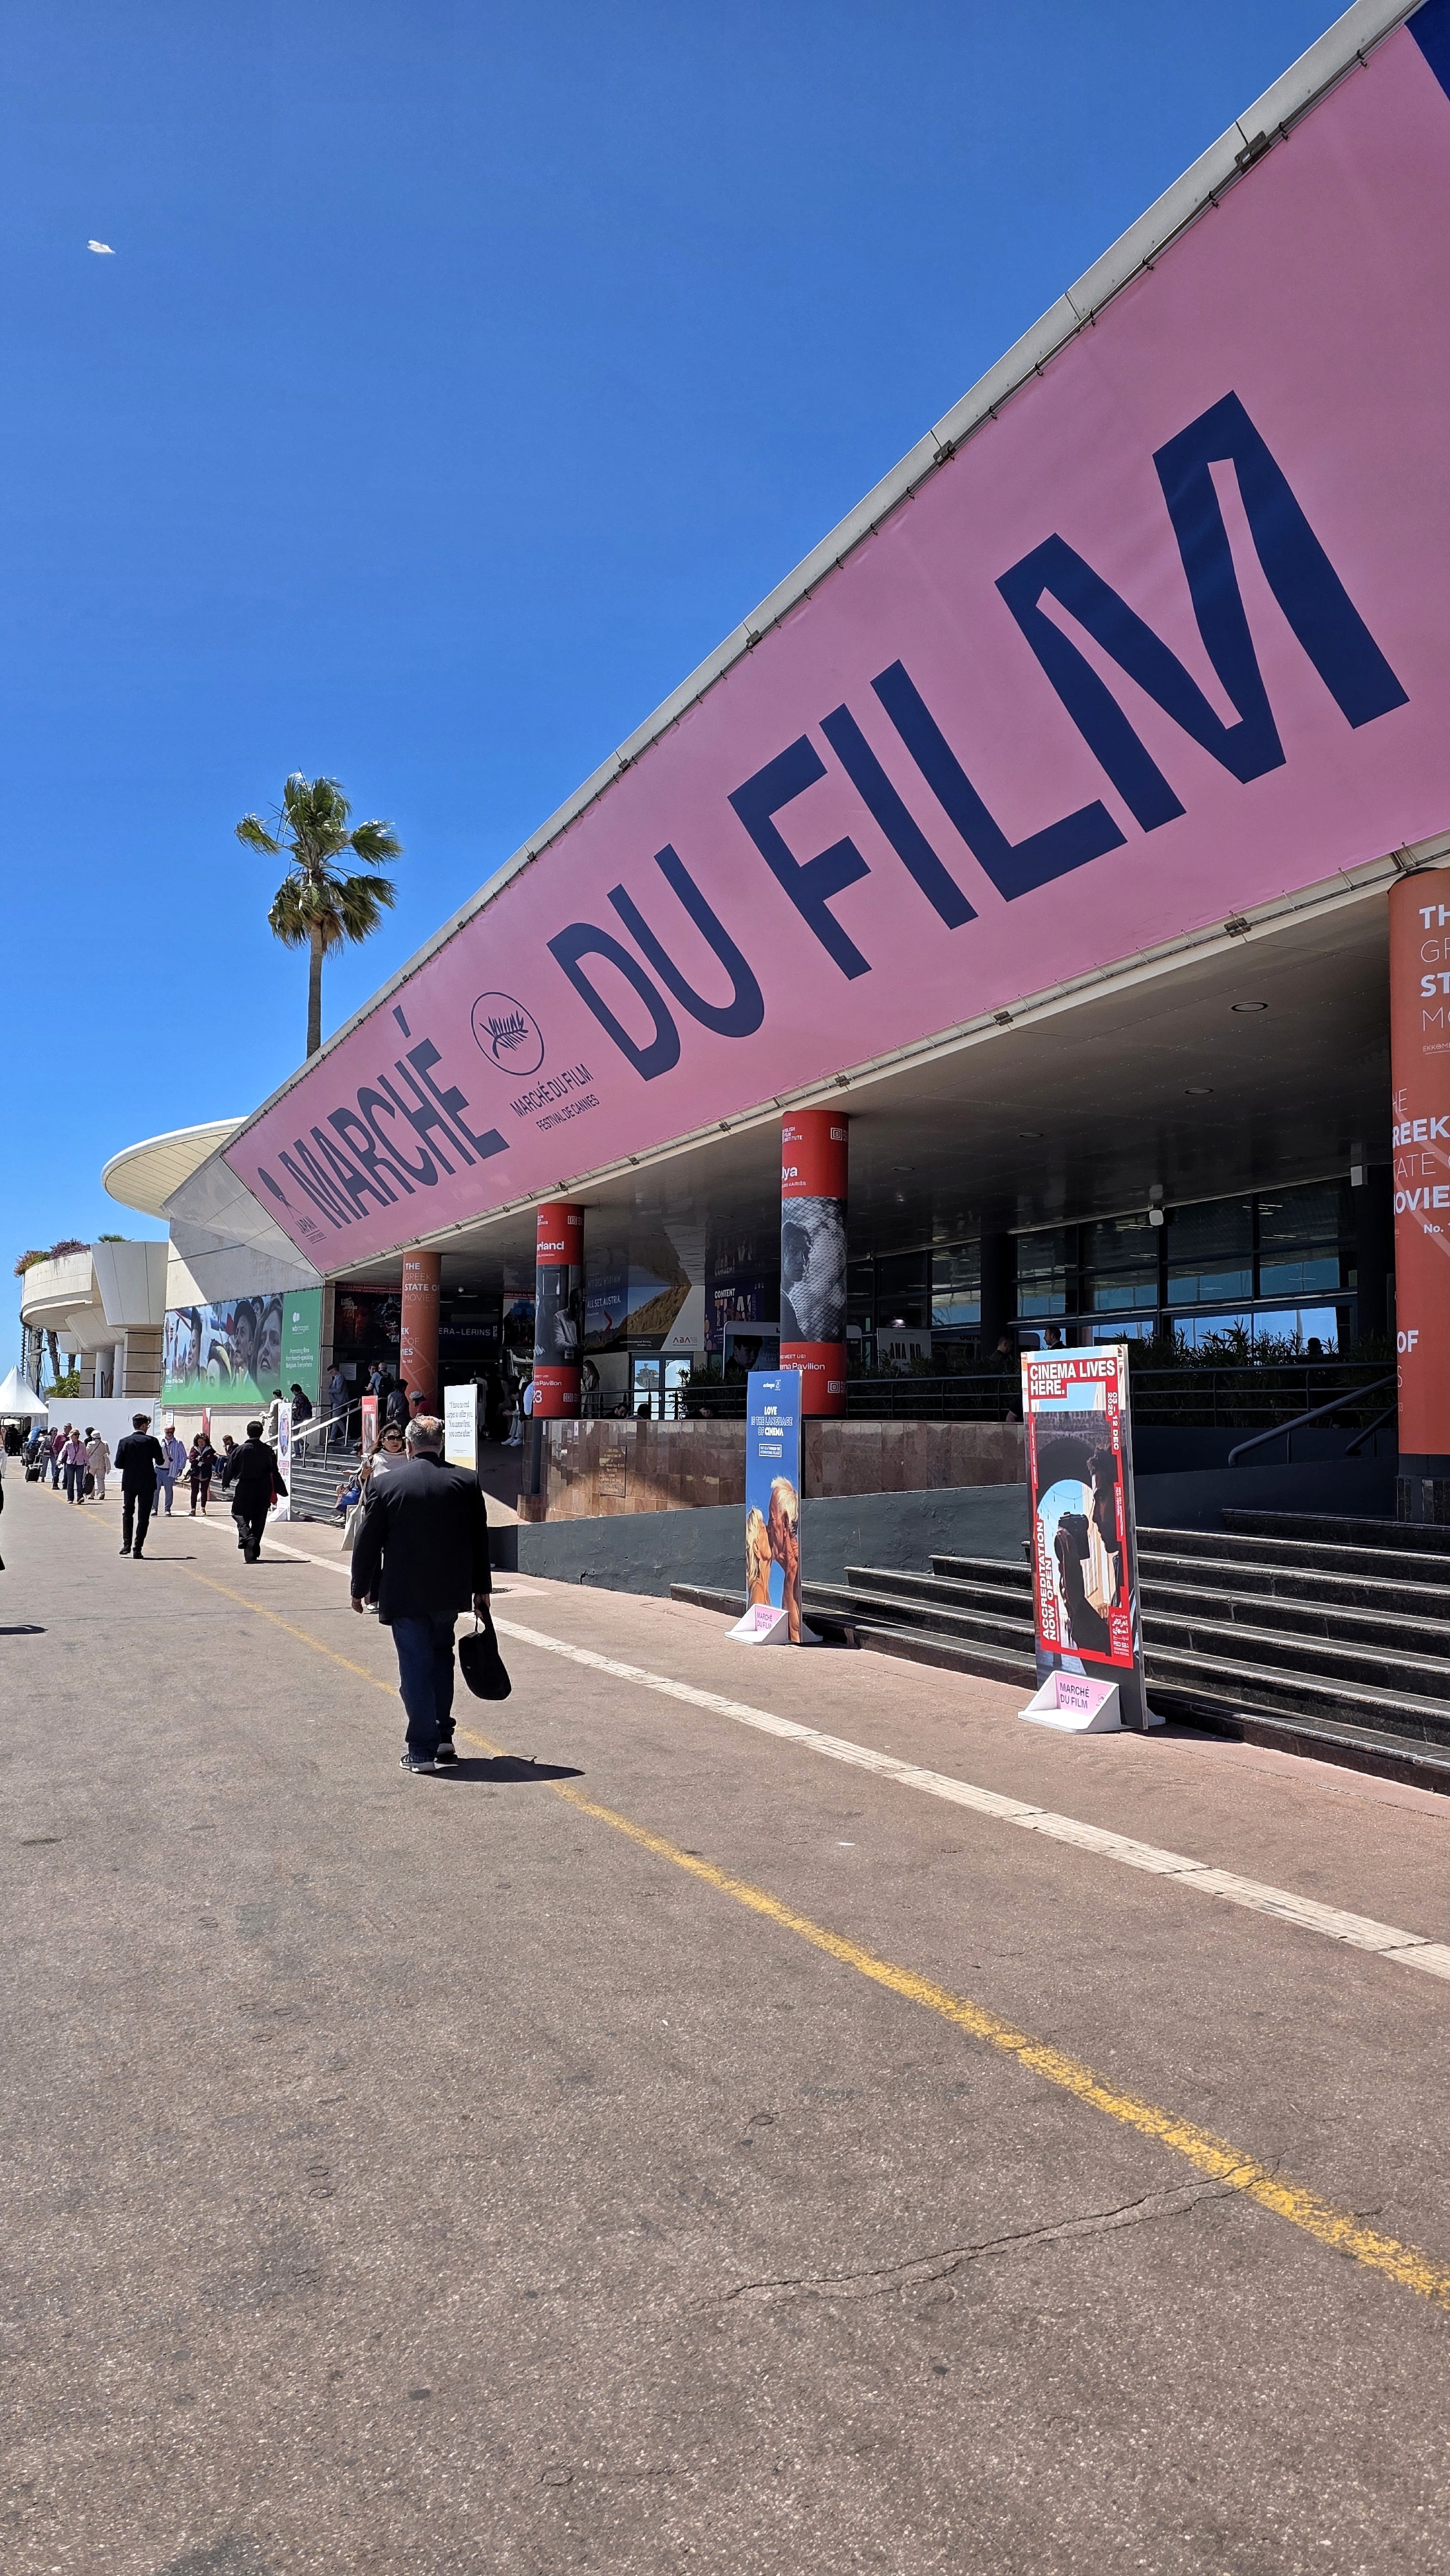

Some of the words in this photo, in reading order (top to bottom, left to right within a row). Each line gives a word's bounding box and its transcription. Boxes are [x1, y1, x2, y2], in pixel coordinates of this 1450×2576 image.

[278, 1005, 510, 1229] MARCHÉ
[547, 843, 764, 1082] DU
[727, 389, 1410, 981] FILM
[510, 1081, 554, 1117] MARCHÉ
[547, 1077, 568, 1098] DU
[561, 1063, 594, 1090] FILM
[1393, 1088, 1408, 1112] HE
[536, 1112, 567, 1132] FESTIVAL
[561, 1106, 575, 1119] DE
[570, 1094, 600, 1114] CANNES
[1393, 1116, 1450, 1148] REEK
[1394, 1186, 1450, 1216] OVIE
[295, 1216, 317, 1234] JAPAN
[1424, 1224, 1444, 1234] No.
[537, 1241, 565, 1251] rland
[405, 1262, 420, 1271] THE
[405, 1273, 431, 1281] GREEK
[715, 1289, 735, 1299] CONTENT
[1397, 1330, 1419, 1353] OF
[792, 1362, 825, 1370] Pavilion
[1030, 1362, 1077, 1380] CINEMA
[1079, 1360, 1115, 1378] LIVES
[1030, 1379, 1065, 1396] HERE.
[764, 1406, 777, 1416] LOVE
[756, 1416, 765, 1426] THE
[765, 1416, 793, 1426] LANGUAGE
[764, 1427, 784, 1437] CINEMA
[1036, 1521, 1050, 1640] ACCREDITATION
[1045, 1559, 1053, 1601] OPEN
[1048, 1604, 1057, 1640] NOW
[1060, 1682, 1089, 1698] MARCHÉ
[1060, 1694, 1070, 1705] DU
[1071, 1697, 1088, 1709] FILM
